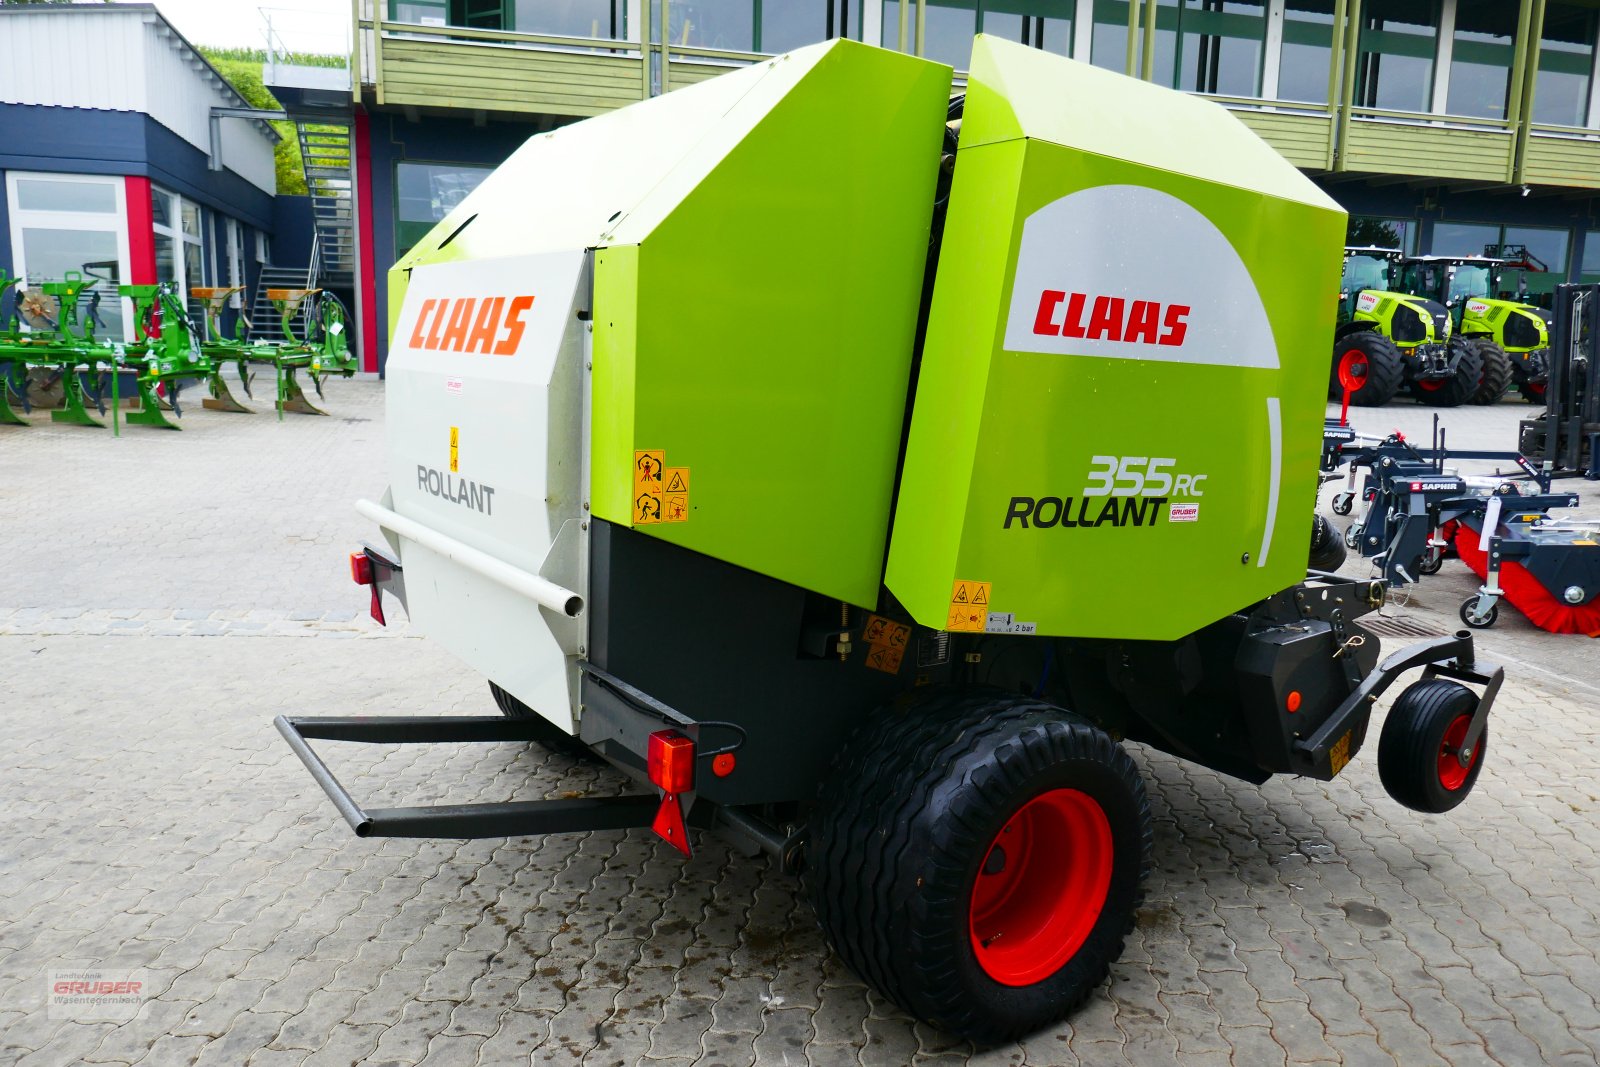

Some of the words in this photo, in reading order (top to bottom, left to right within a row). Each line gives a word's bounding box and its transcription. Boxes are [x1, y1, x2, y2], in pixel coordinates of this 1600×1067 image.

[409, 295, 535, 356] CLAAS
[1033, 289, 1191, 346] CLAAS
[417, 464, 495, 516] ROLLANT
[1083, 455, 1176, 497] 355
[1173, 474, 1207, 497] RC
[1003, 496, 1168, 529] ROLLANT
[1171, 508, 1197, 516] GRUBER
[1014, 624, 1020, 632] 2
[1021, 624, 1034, 632] bar
